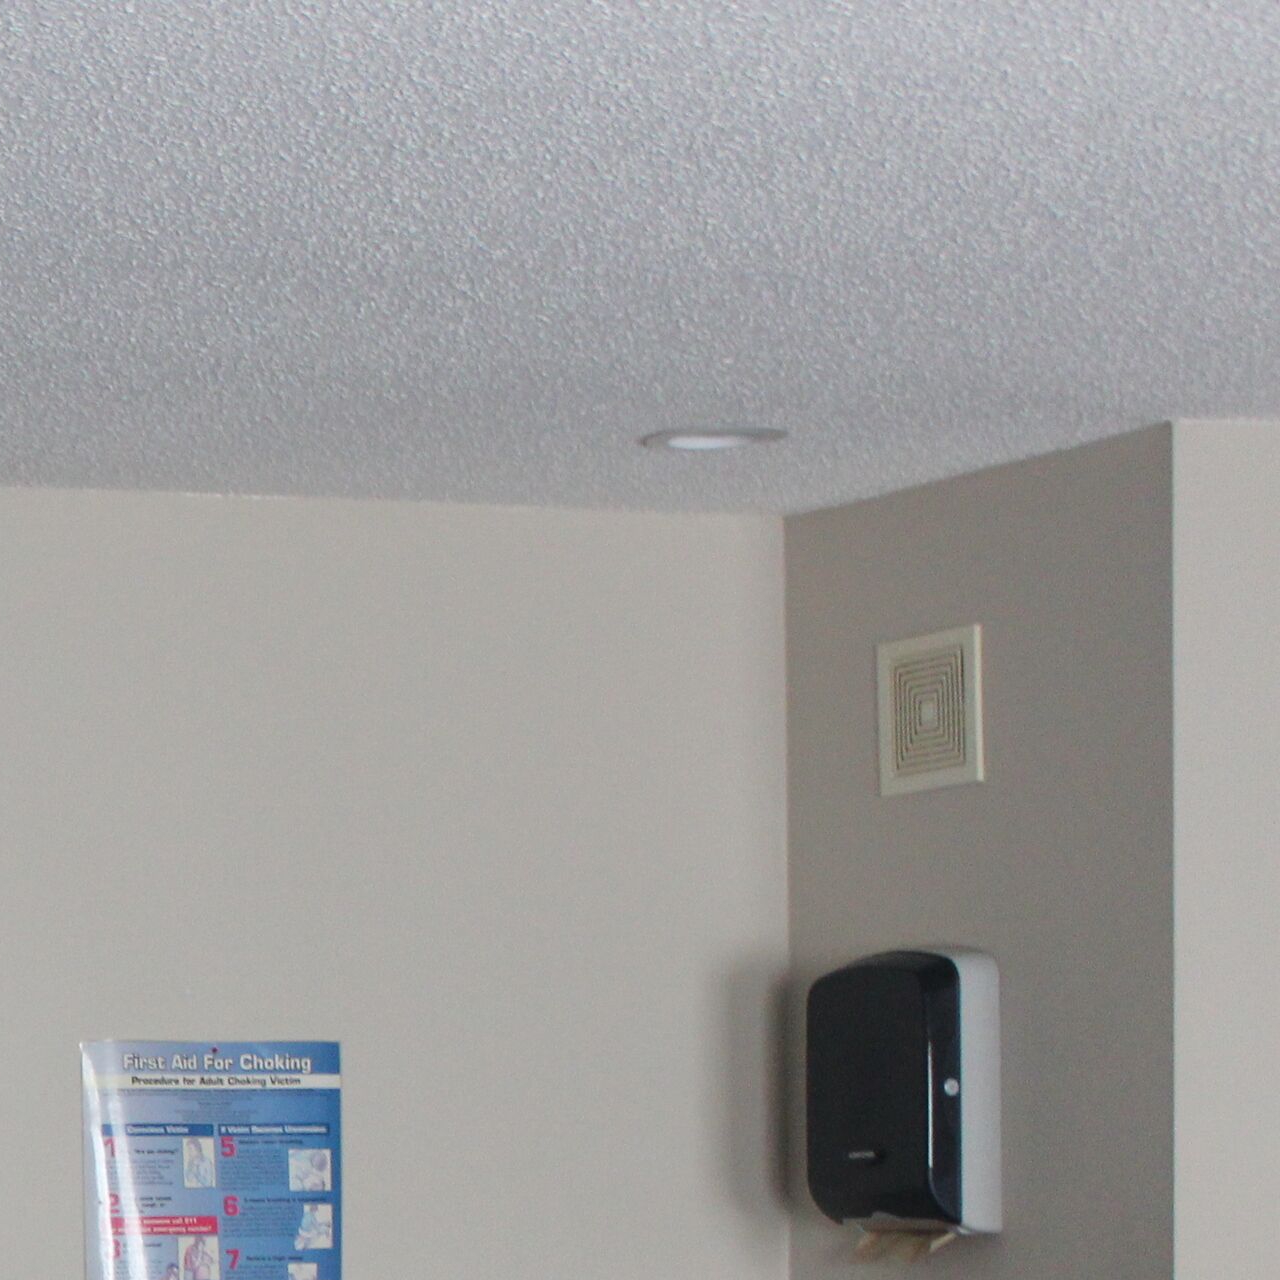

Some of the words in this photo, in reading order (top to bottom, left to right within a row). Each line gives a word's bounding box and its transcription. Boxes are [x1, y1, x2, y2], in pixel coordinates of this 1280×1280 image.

[123, 1054, 165, 1070] First
[172, 1054, 197, 1070] Aid
[204, 1054, 233, 1070] For
[239, 1053, 312, 1074] Choking
[131, 1076, 179, 1086] Procedure
[183, 1076, 196, 1086] for
[199, 1075, 224, 1086] Adult
[227, 1075, 267, 1088] Choking
[270, 1075, 301, 1086] Victim
[220, 1137, 237, 1157] 5
[223, 1196, 240, 1216] 6
[226, 1249, 240, 1269] 7
